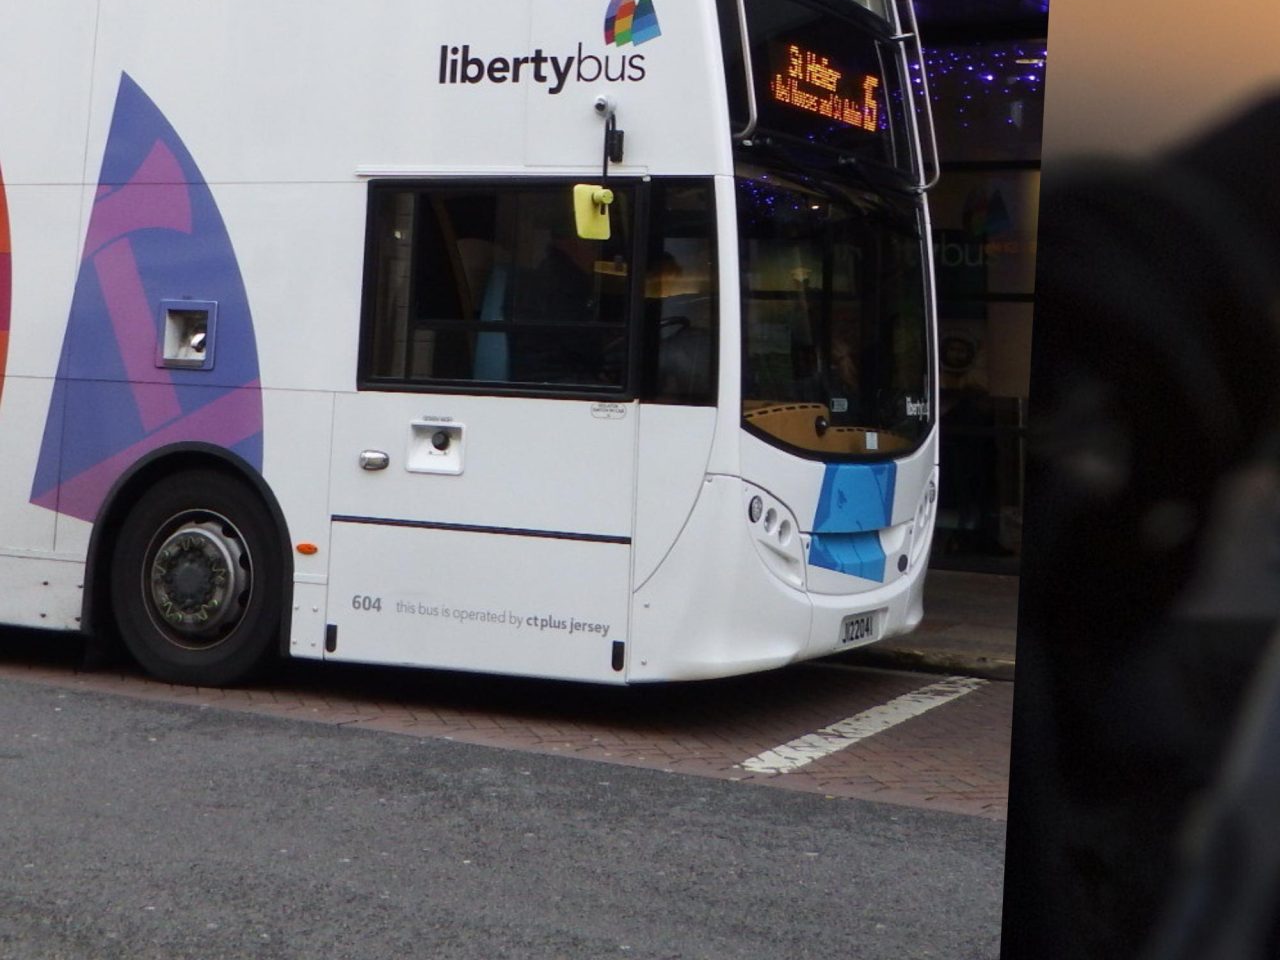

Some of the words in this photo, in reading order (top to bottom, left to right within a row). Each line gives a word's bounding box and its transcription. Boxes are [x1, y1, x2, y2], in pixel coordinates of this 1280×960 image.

[438, 41, 646, 94] libertybus
[351, 594, 383, 613] 604
[396, 600, 416, 614] this
[418, 601, 439, 617] bus
[441, 603, 451, 618] is
[452, 608, 506, 623] operated
[508, 610, 523, 628] by
[569, 617, 611, 637] jersey
